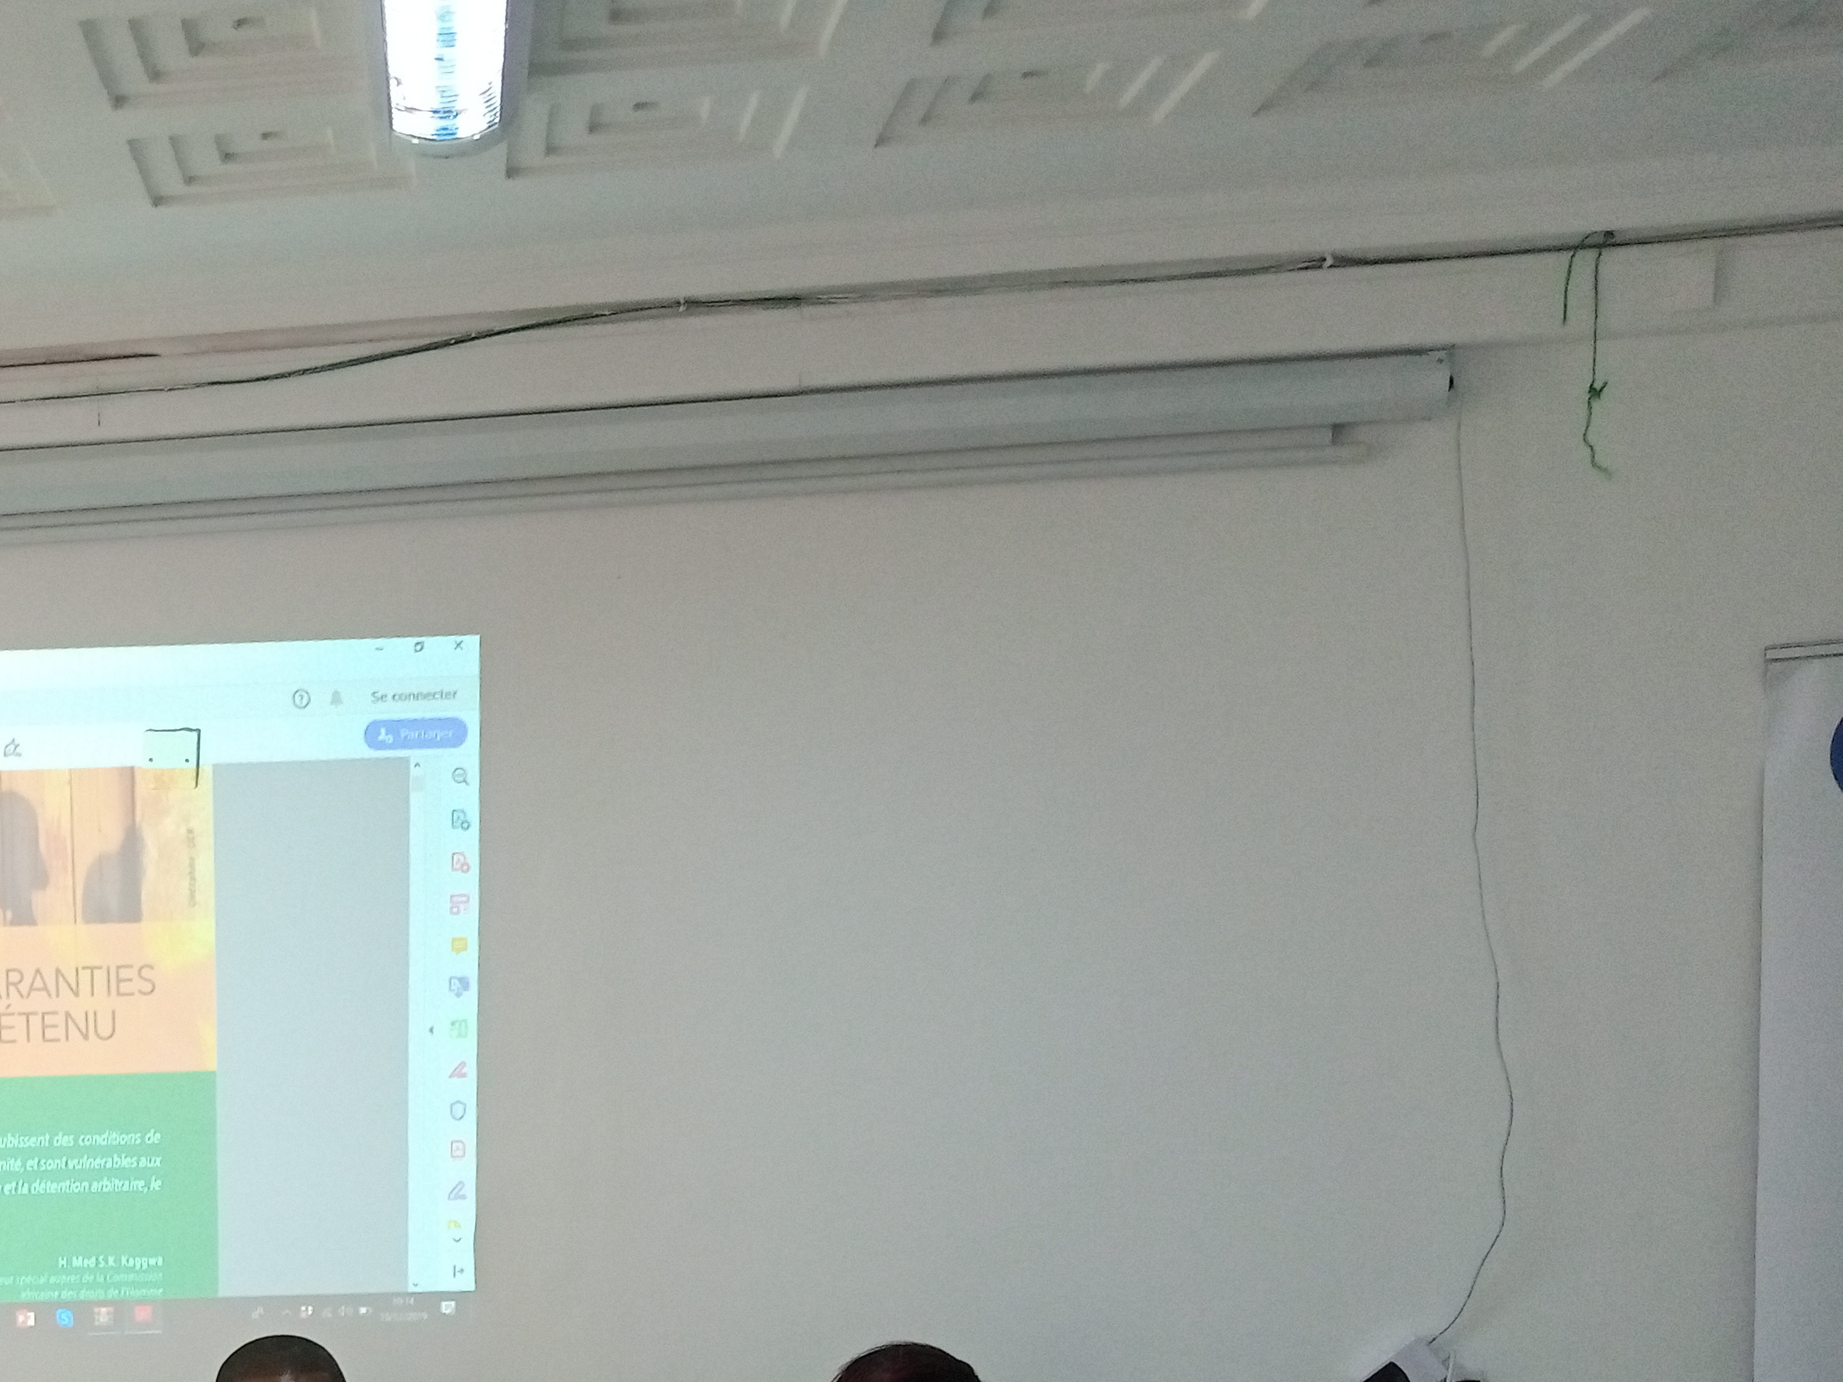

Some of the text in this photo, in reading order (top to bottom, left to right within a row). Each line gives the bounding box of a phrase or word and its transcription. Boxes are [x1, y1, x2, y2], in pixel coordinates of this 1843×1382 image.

[370, 688, 458, 704] Se connecter
[53, 1131, 75, 1147] des
[78, 1129, 142, 1146] conditions
[144, 1128, 162, 1145] de
[26, 1156, 40, 1171] et
[40, 1155, 66, 1170] sont
[67, 1154, 138, 1170] vulnérables
[138, 1155, 162, 1169] aux
[3, 1180, 18, 1196] et
[18, 1179, 29, 1195] la
[30, 1178, 90, 1195] détention
[90, 1176, 149, 1195] arbitraire,
[150, 1175, 163, 1191] le
